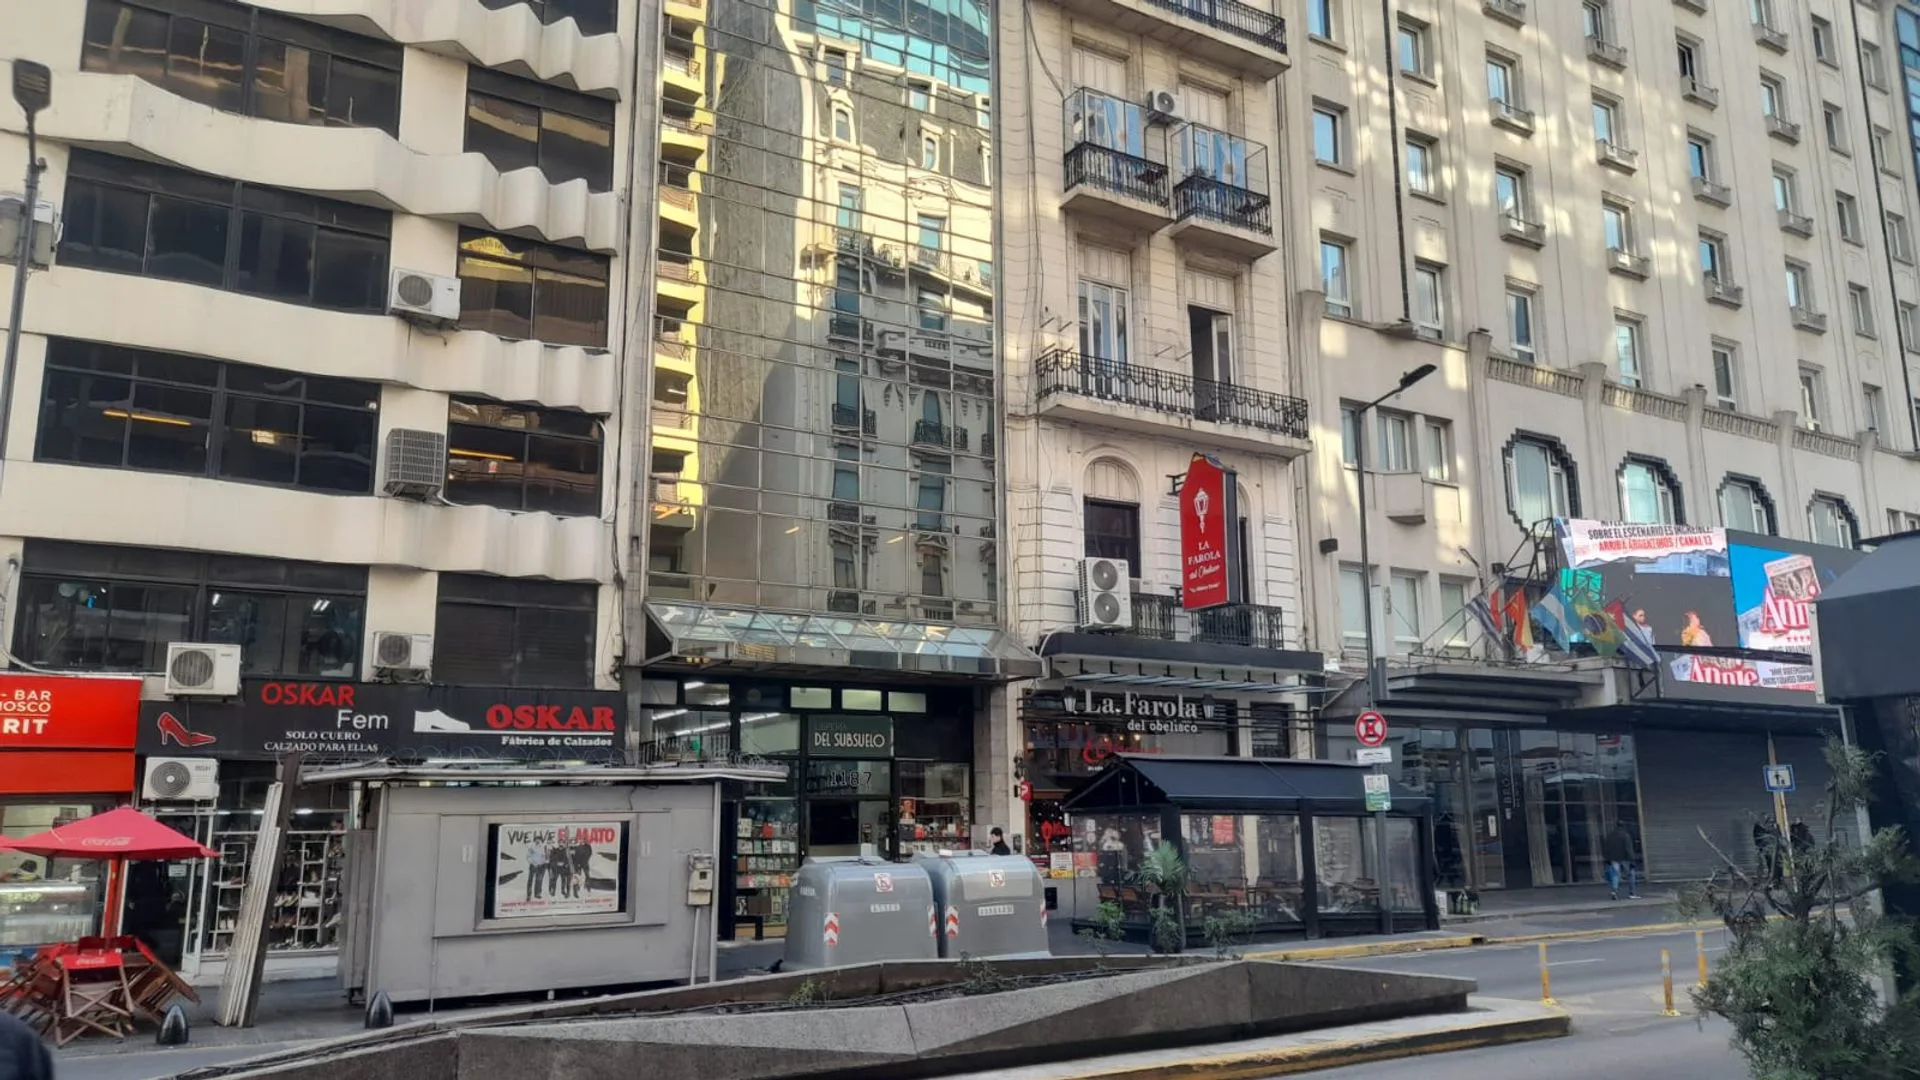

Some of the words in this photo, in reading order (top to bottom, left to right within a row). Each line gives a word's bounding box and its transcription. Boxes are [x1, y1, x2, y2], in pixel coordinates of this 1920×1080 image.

[1588, 528, 1613, 540] SOBRE
[1198, 540, 1210, 551] LA
[1188, 550, 1220, 565] FAROLA
[14, 689, 52, 701] BAR
[261, 682, 355, 706] OSKAR
[1084, 689, 1114, 714] La
[1124, 691, 1198, 718] Farola
[337, 709, 389, 730] Fem
[486, 703, 616, 731] OSKAR
[2, 718, 49, 735] RIT
[1127, 719, 1145, 731] del
[1150, 720, 1198, 733] obelisco
[285, 731, 318, 740] SOLO
[320, 731, 361, 741] CUERO
[501, 735, 545, 746] Fábrica
[547, 737, 561, 746] de
[814, 732, 831, 747] DEL
[834, 732, 885, 748] SUBSUELO
[264, 741, 317, 752] CALZADO
[318, 742, 346, 752] PARA
[347, 743, 378, 753] ELLAS
[507, 829, 556, 845] VUELVE
[576, 827, 615, 845] MATO
